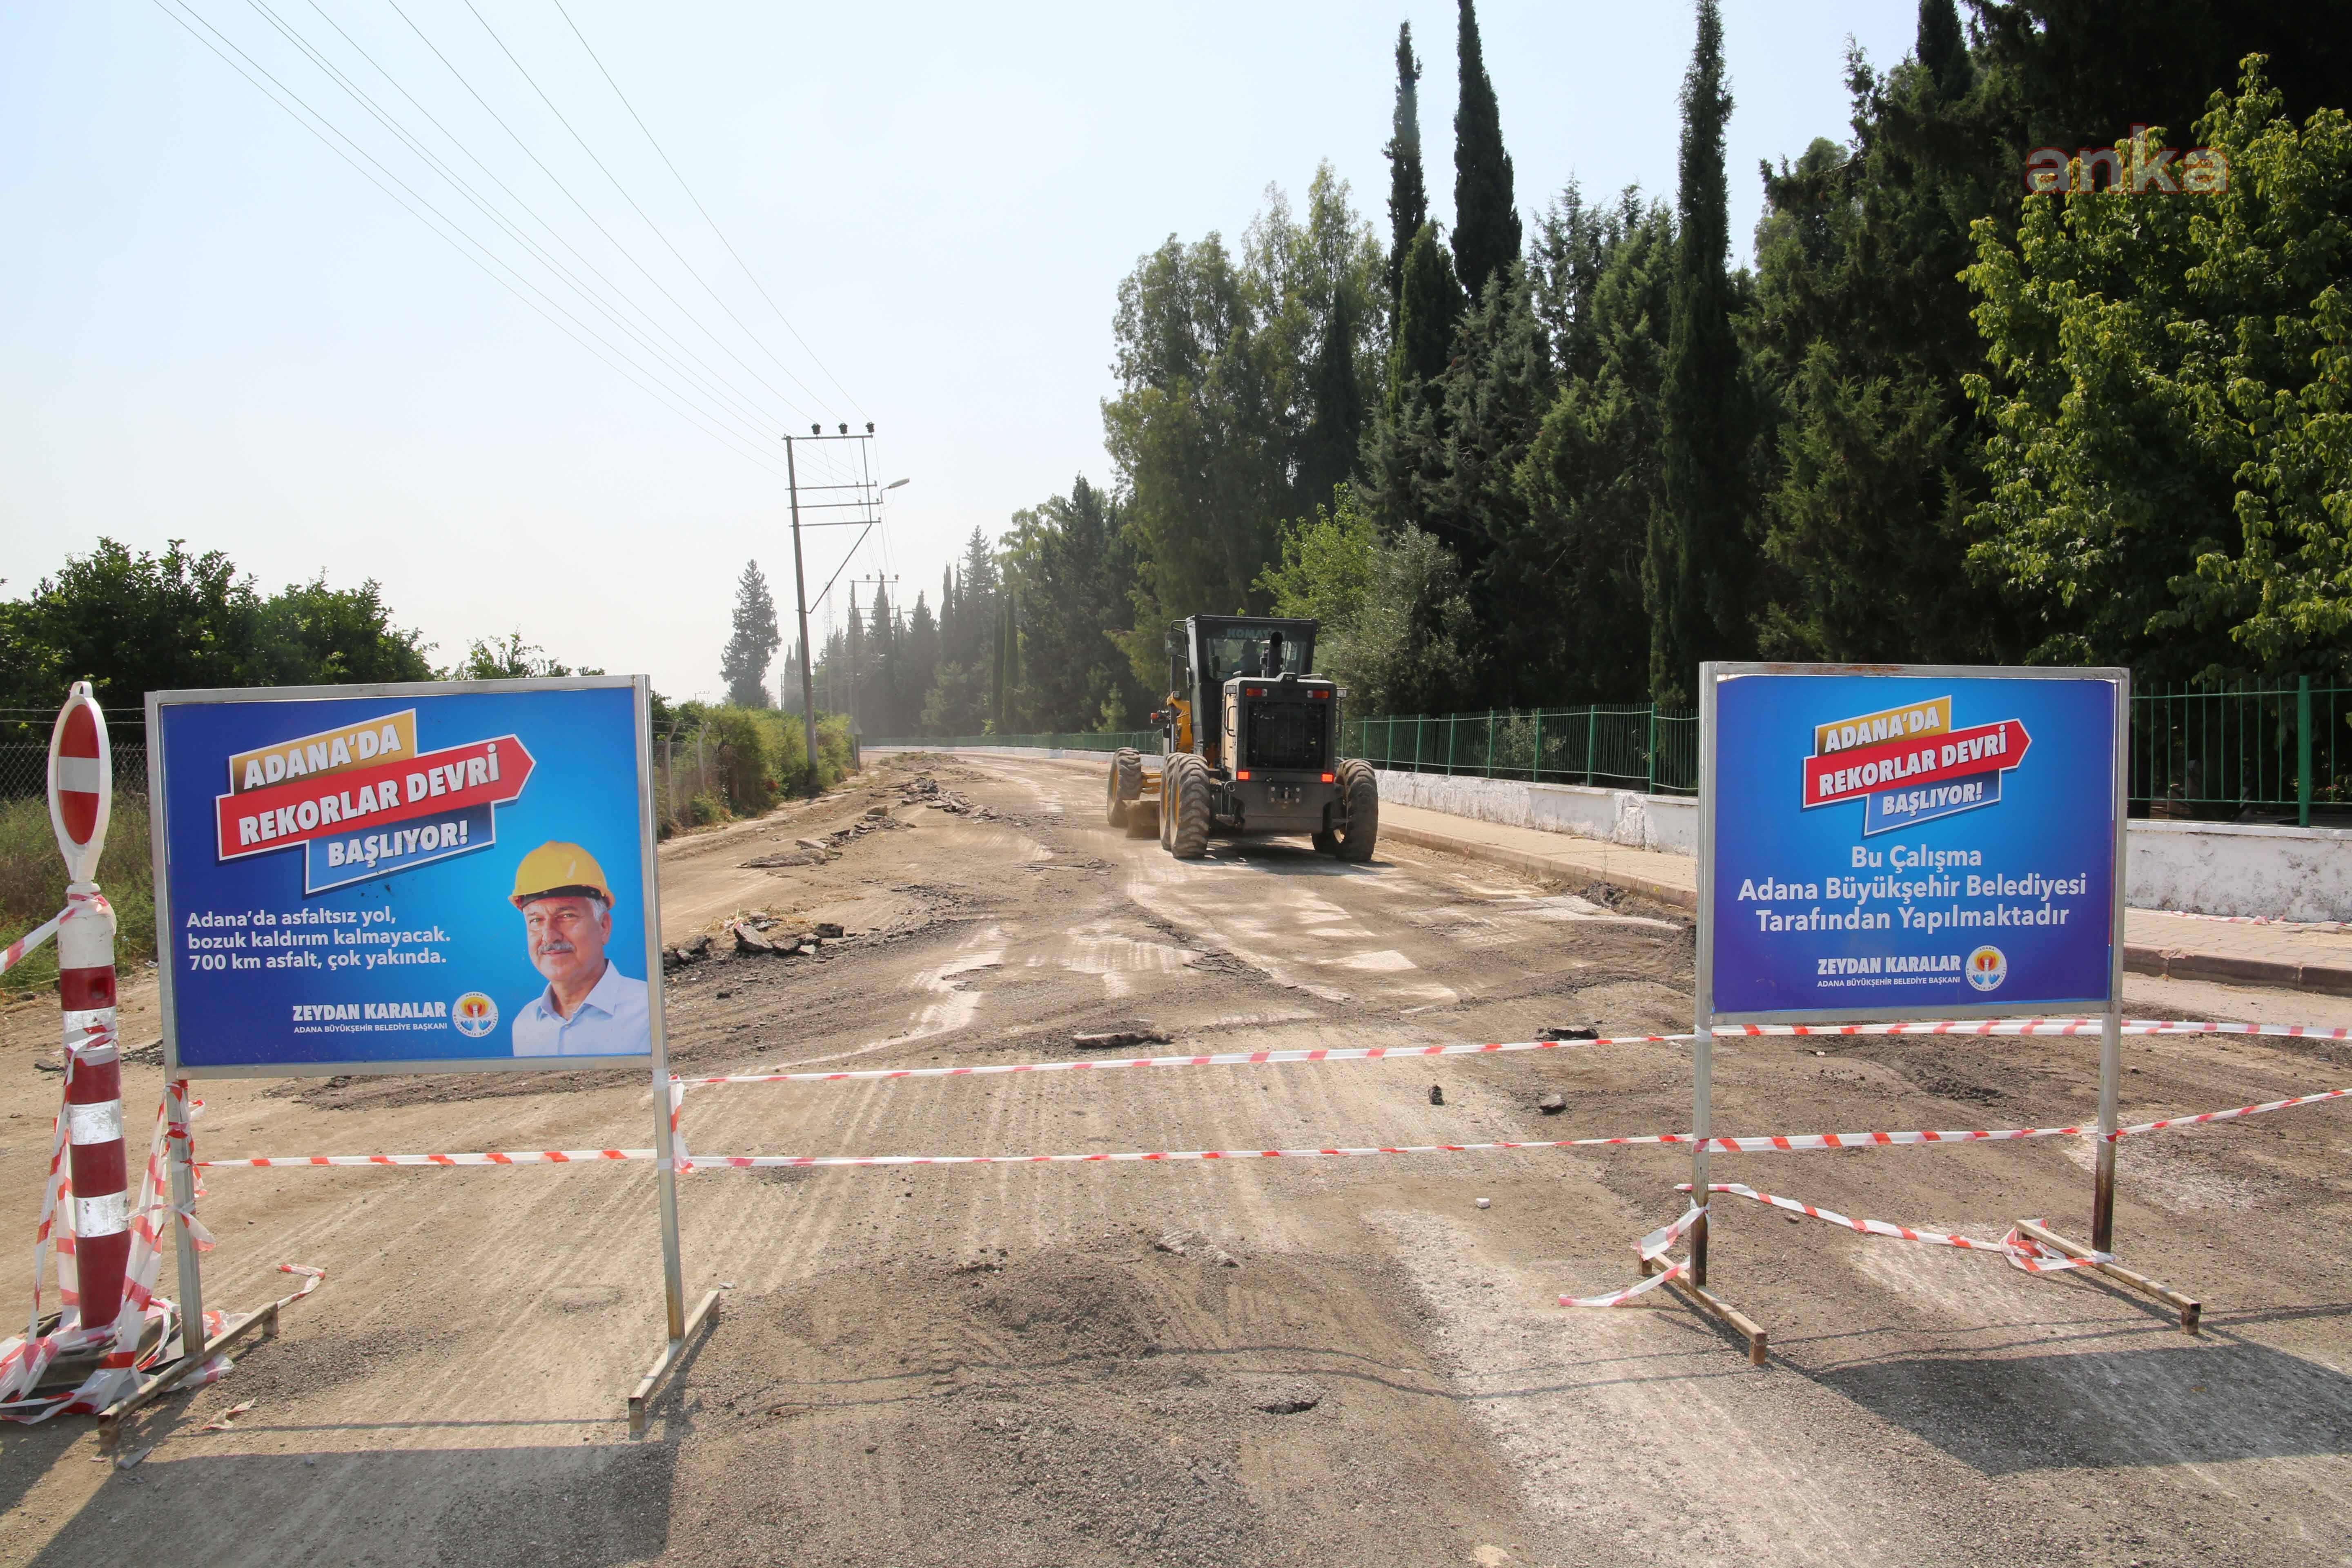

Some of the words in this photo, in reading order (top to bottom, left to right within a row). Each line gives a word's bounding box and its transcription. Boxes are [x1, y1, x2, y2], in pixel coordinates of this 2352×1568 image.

[1820, 749, 1937, 797] REKORLAR
[1941, 725, 2006, 767] DEVRİ
[238, 780, 400, 846] REKORLAR
[406, 743, 499, 803] DEVRİ
[1882, 782, 1983, 817] BAŞLIYOR!
[328, 820, 468, 868] BAŞLIYOR!
[1851, 846, 1882, 868] Bu
[1889, 844, 1981, 873] Çalışma
[1738, 877, 1817, 901] Adana
[1826, 874, 1960, 905] Büyükşehir
[1966, 873, 2086, 902] Belediyesi
[281, 908, 357, 925] asfaltsız
[361, 906, 396, 927] yol,
[1756, 906, 1890, 932] Tarafından
[1898, 903, 2069, 934] Yapılmaktadır
[188, 932, 246, 949] bozuk
[252, 930, 329, 947] kaldırım
[334, 926, 450, 947] kalmayacak.
[189, 954, 226, 971] 700
[232, 953, 261, 969] km
[266, 951, 323, 969] asfalt,
[328, 950, 361, 971] çok
[366, 947, 447, 969] yakında.
[1817, 957, 1880, 975] ZEYDAN
[1886, 955, 1961, 973] KARALAR
[1846, 978, 1892, 988] BÜYÜKŞEHİR
[1894, 976, 1926, 985] BELEDİYE
[1927, 976, 1961, 986] BAŞKANI
[293, 1004, 360, 1022] ZEYDAN
[365, 1002, 447, 1020] KARALAR
[294, 1025, 323, 1033] ADANA
[325, 1023, 373, 1033] BÜYÜKŞEHİR
[375, 1022, 411, 1031] BELEDİYE
[413, 1022, 448, 1031] BAŞKANI
